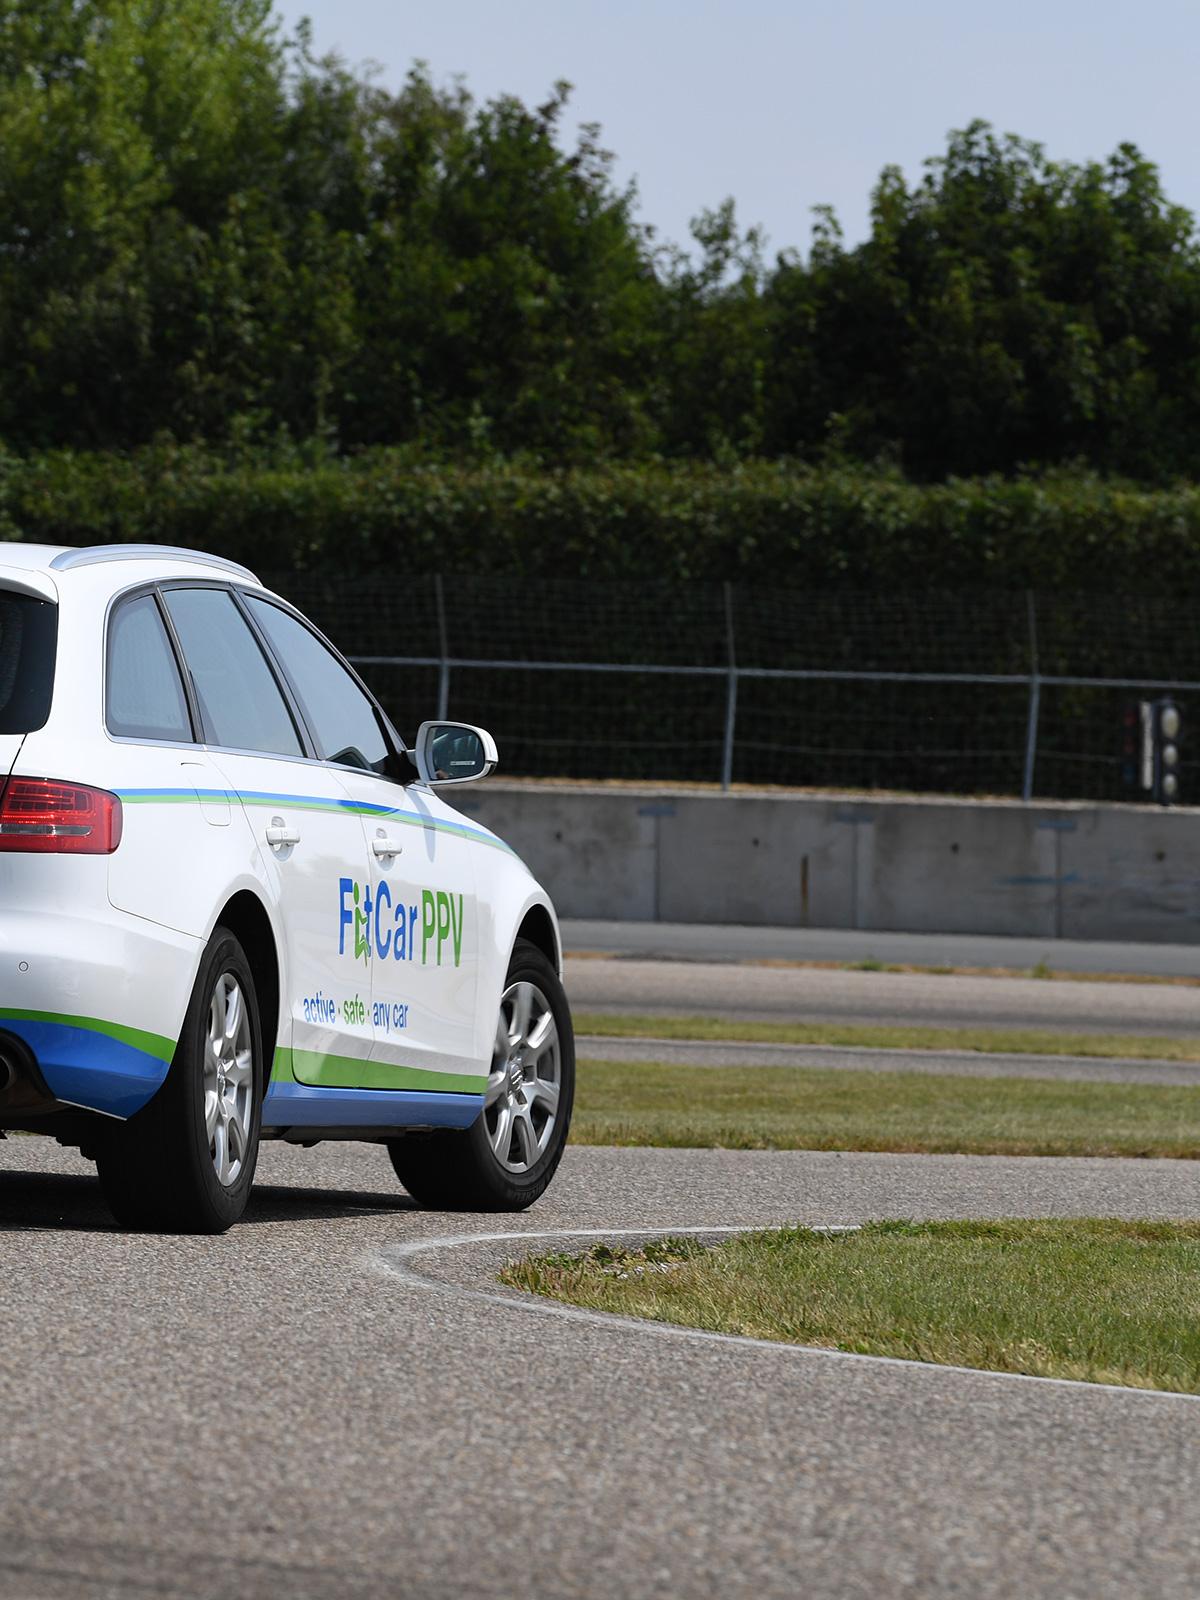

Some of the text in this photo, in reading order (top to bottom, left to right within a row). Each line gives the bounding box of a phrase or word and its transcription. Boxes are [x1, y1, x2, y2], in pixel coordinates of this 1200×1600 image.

[303, 991, 408, 1034] active safe any car
